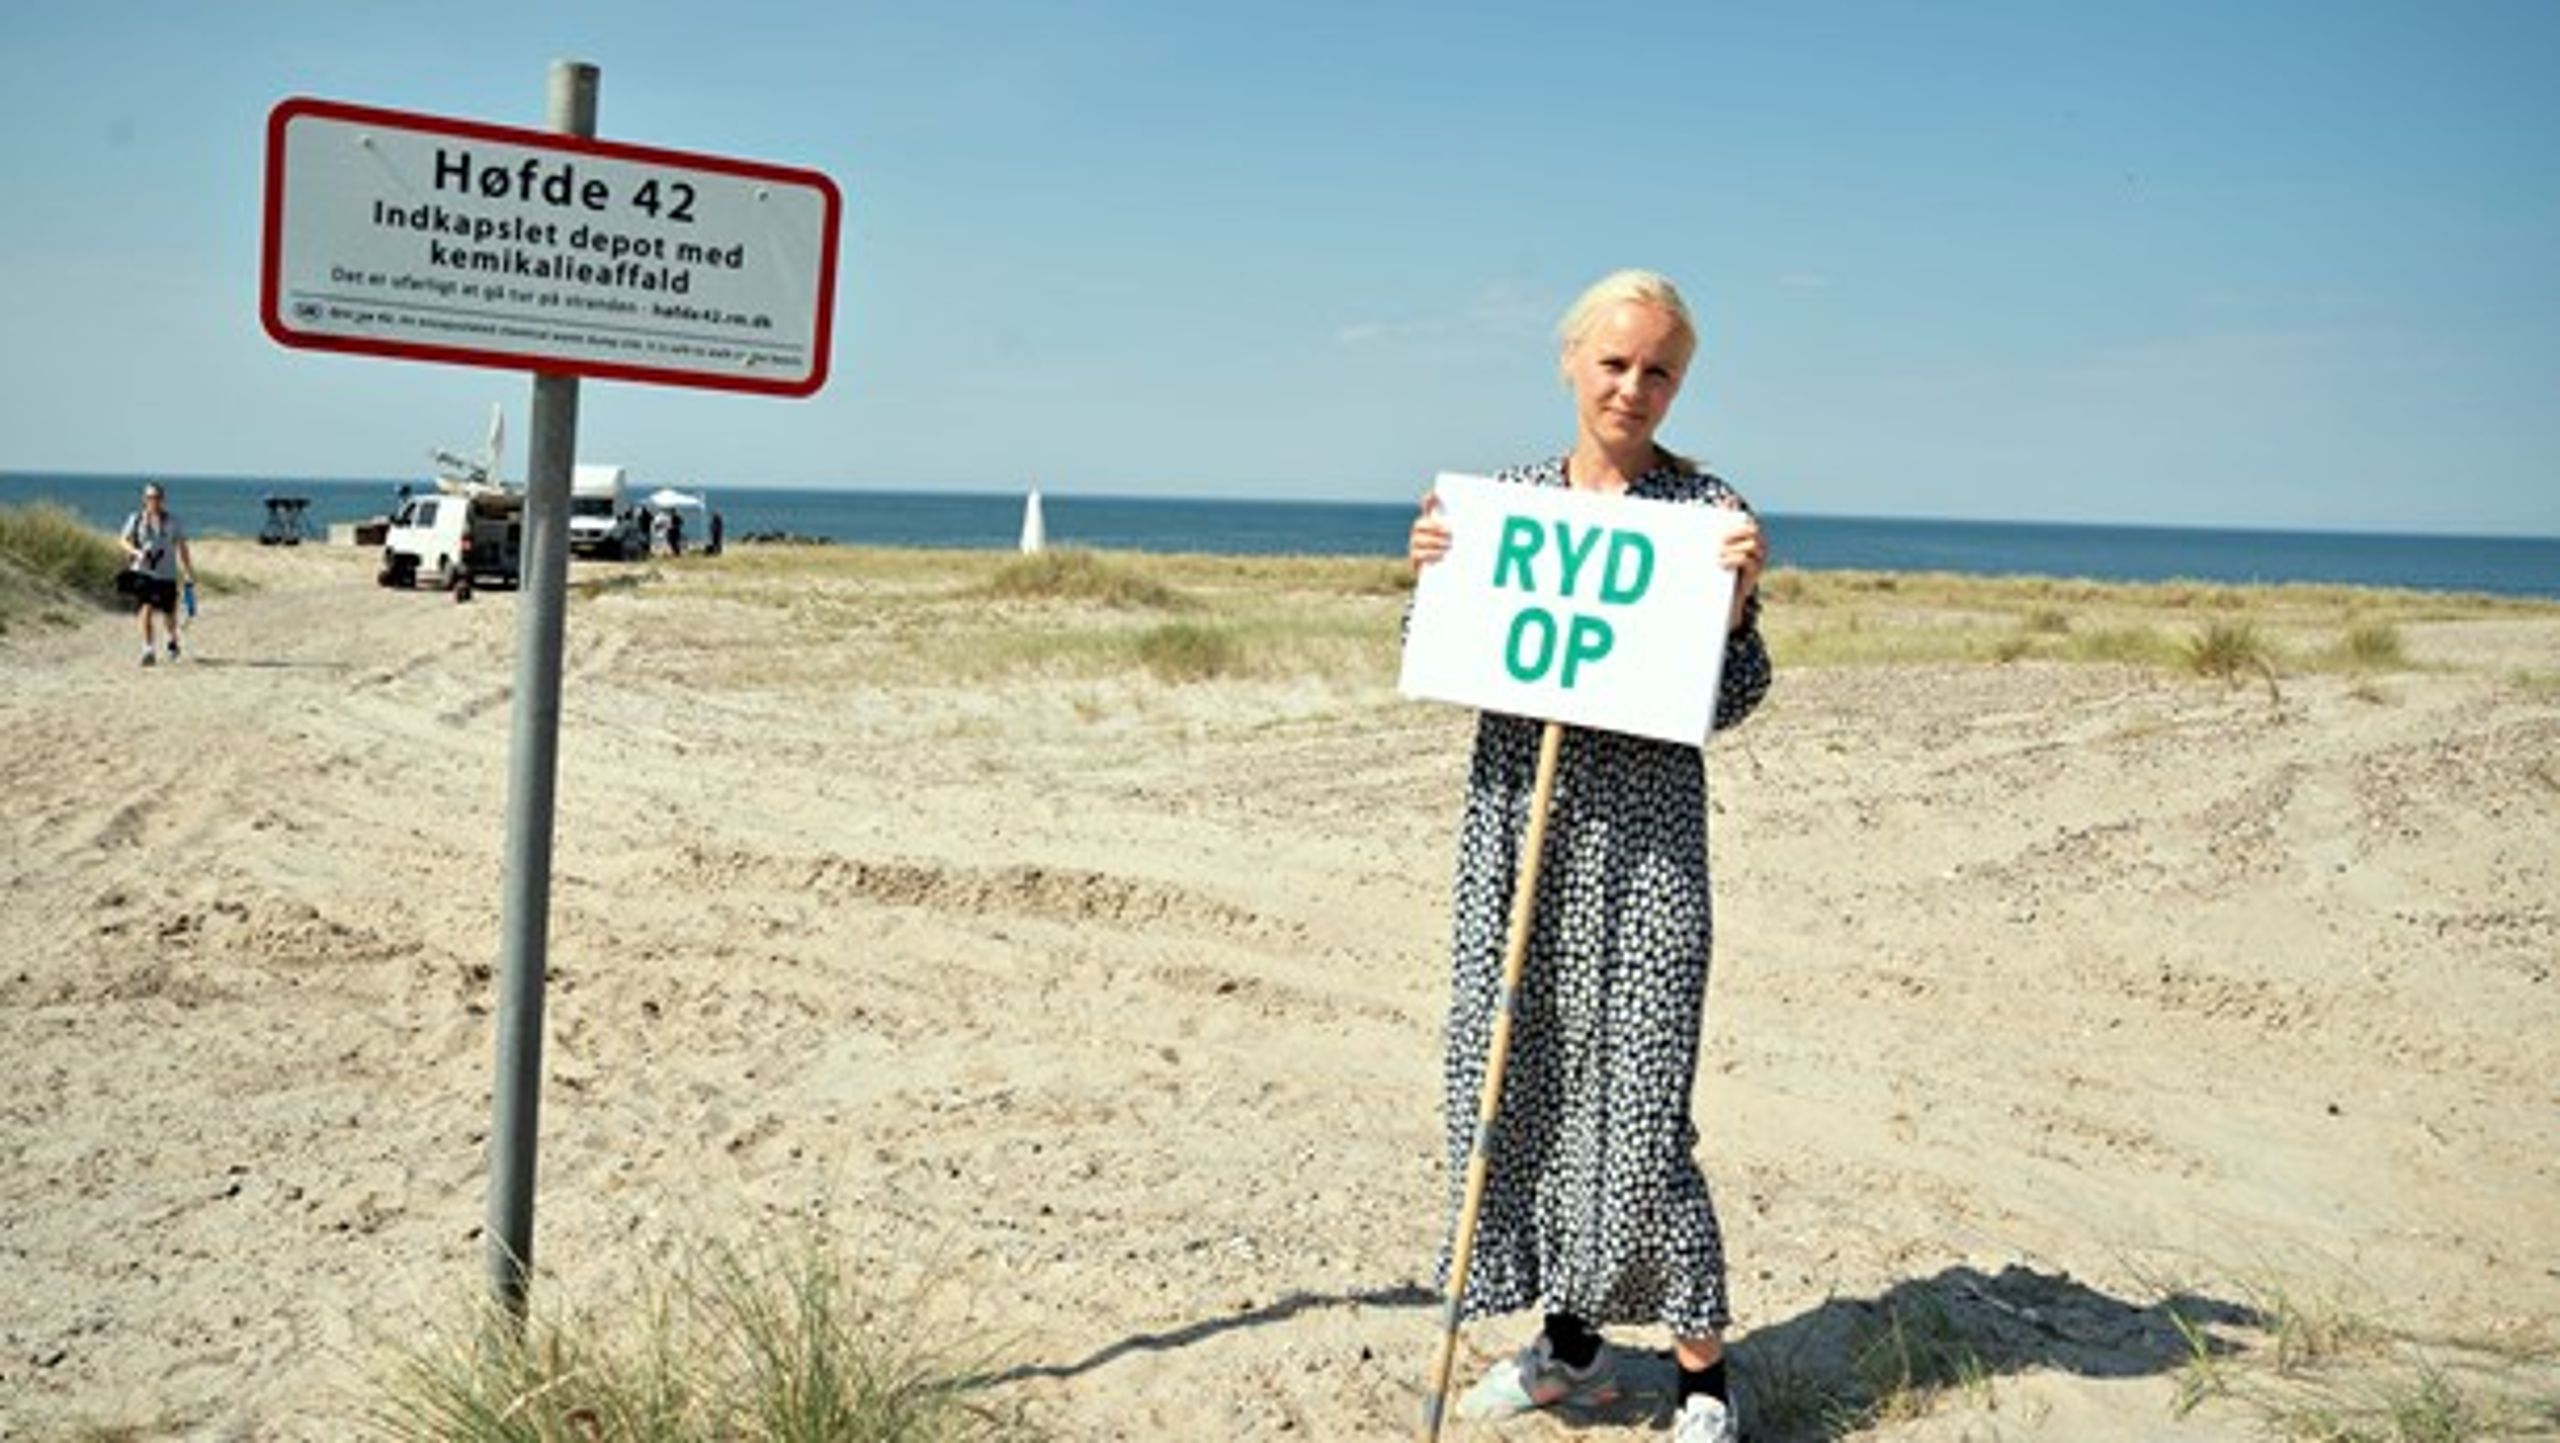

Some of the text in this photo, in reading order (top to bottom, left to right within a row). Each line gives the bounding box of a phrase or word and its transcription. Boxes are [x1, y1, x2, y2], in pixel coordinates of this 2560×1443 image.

[434, 149, 697, 223] Høfde 42
[373, 201, 744, 269] Indkapslet depot med
[431, 239, 691, 294] kemikalieaffald
[1493, 515, 1655, 605] RYD
[1505, 607, 1614, 688] OP
